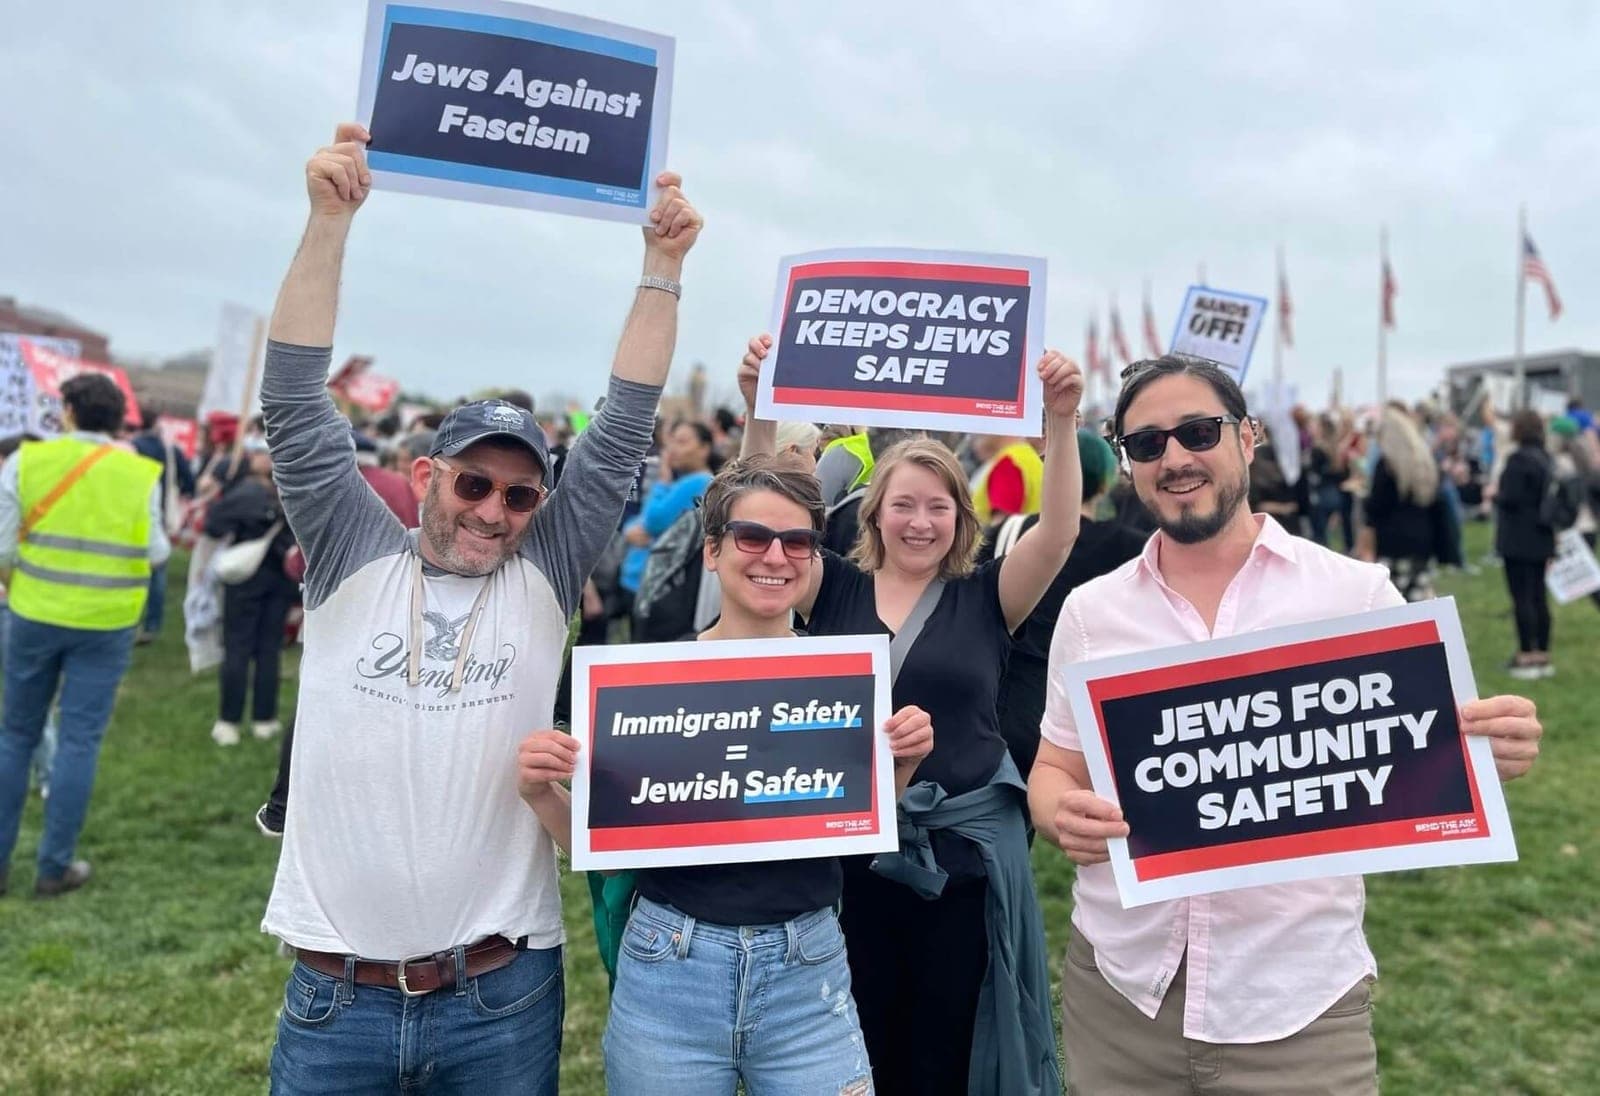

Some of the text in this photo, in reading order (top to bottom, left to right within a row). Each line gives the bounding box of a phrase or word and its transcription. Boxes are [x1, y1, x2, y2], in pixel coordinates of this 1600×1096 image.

[391, 54, 642, 119] Jews Against
[438, 104, 591, 154] Fascism
[795, 288, 1018, 323] DEMOCRACY
[795, 320, 1011, 356] KEEPS JEWS
[1189, 313, 1245, 343] OFF!
[854, 354, 949, 386] SAFE
[414, 702, 457, 712] OLDEST
[461, 693, 516, 709] BREWERY
[611, 699, 862, 738] Immigrant Safety
[1152, 672, 1395, 746] JEWS FOR
[1134, 709, 1438, 793] COMMUNITY
[631, 765, 845, 805] Jewish Safety
[1197, 764, 1394, 830] SAFETY
